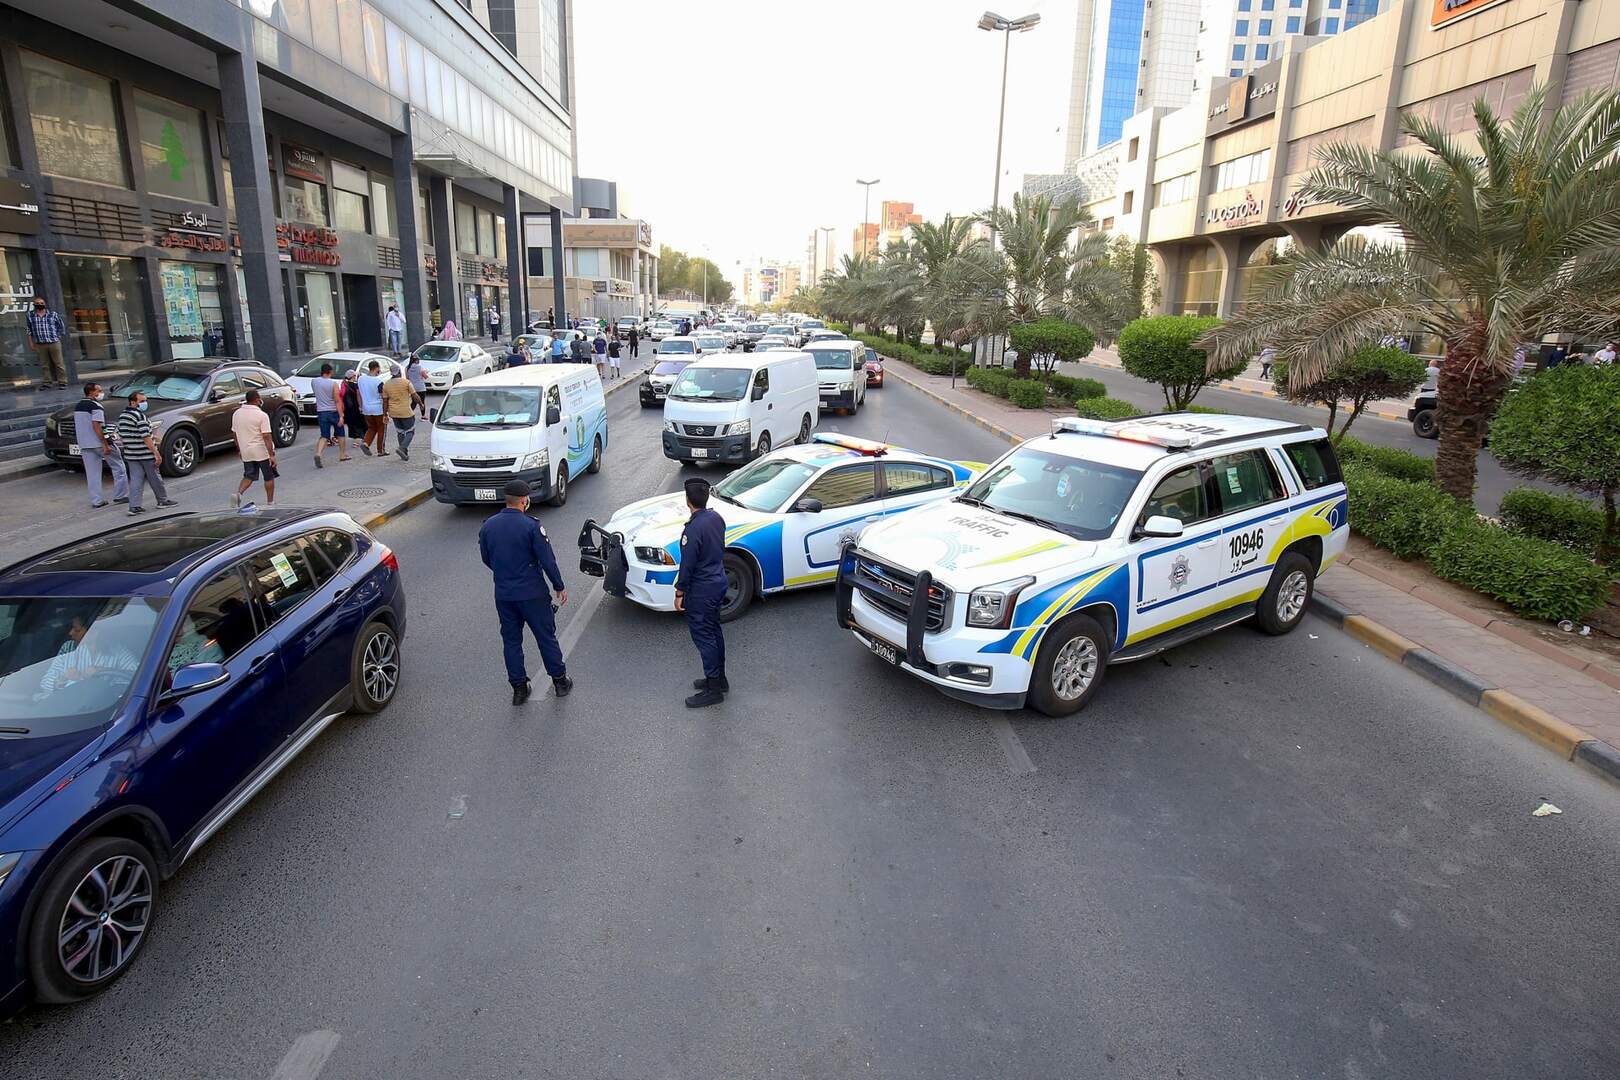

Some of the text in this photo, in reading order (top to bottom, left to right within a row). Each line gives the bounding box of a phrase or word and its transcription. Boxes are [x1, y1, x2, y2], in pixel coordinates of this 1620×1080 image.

[182, 211, 208, 227] المركز
[1207, 208, 1221, 223] AL
[1220, 200, 1264, 221] OSTORA
[948, 516, 1008, 538] TRAFFIC
[1229, 528, 1263, 558] 10946
[1230, 553, 1258, 573] مرور
[875, 643, 896, 662] 10946
